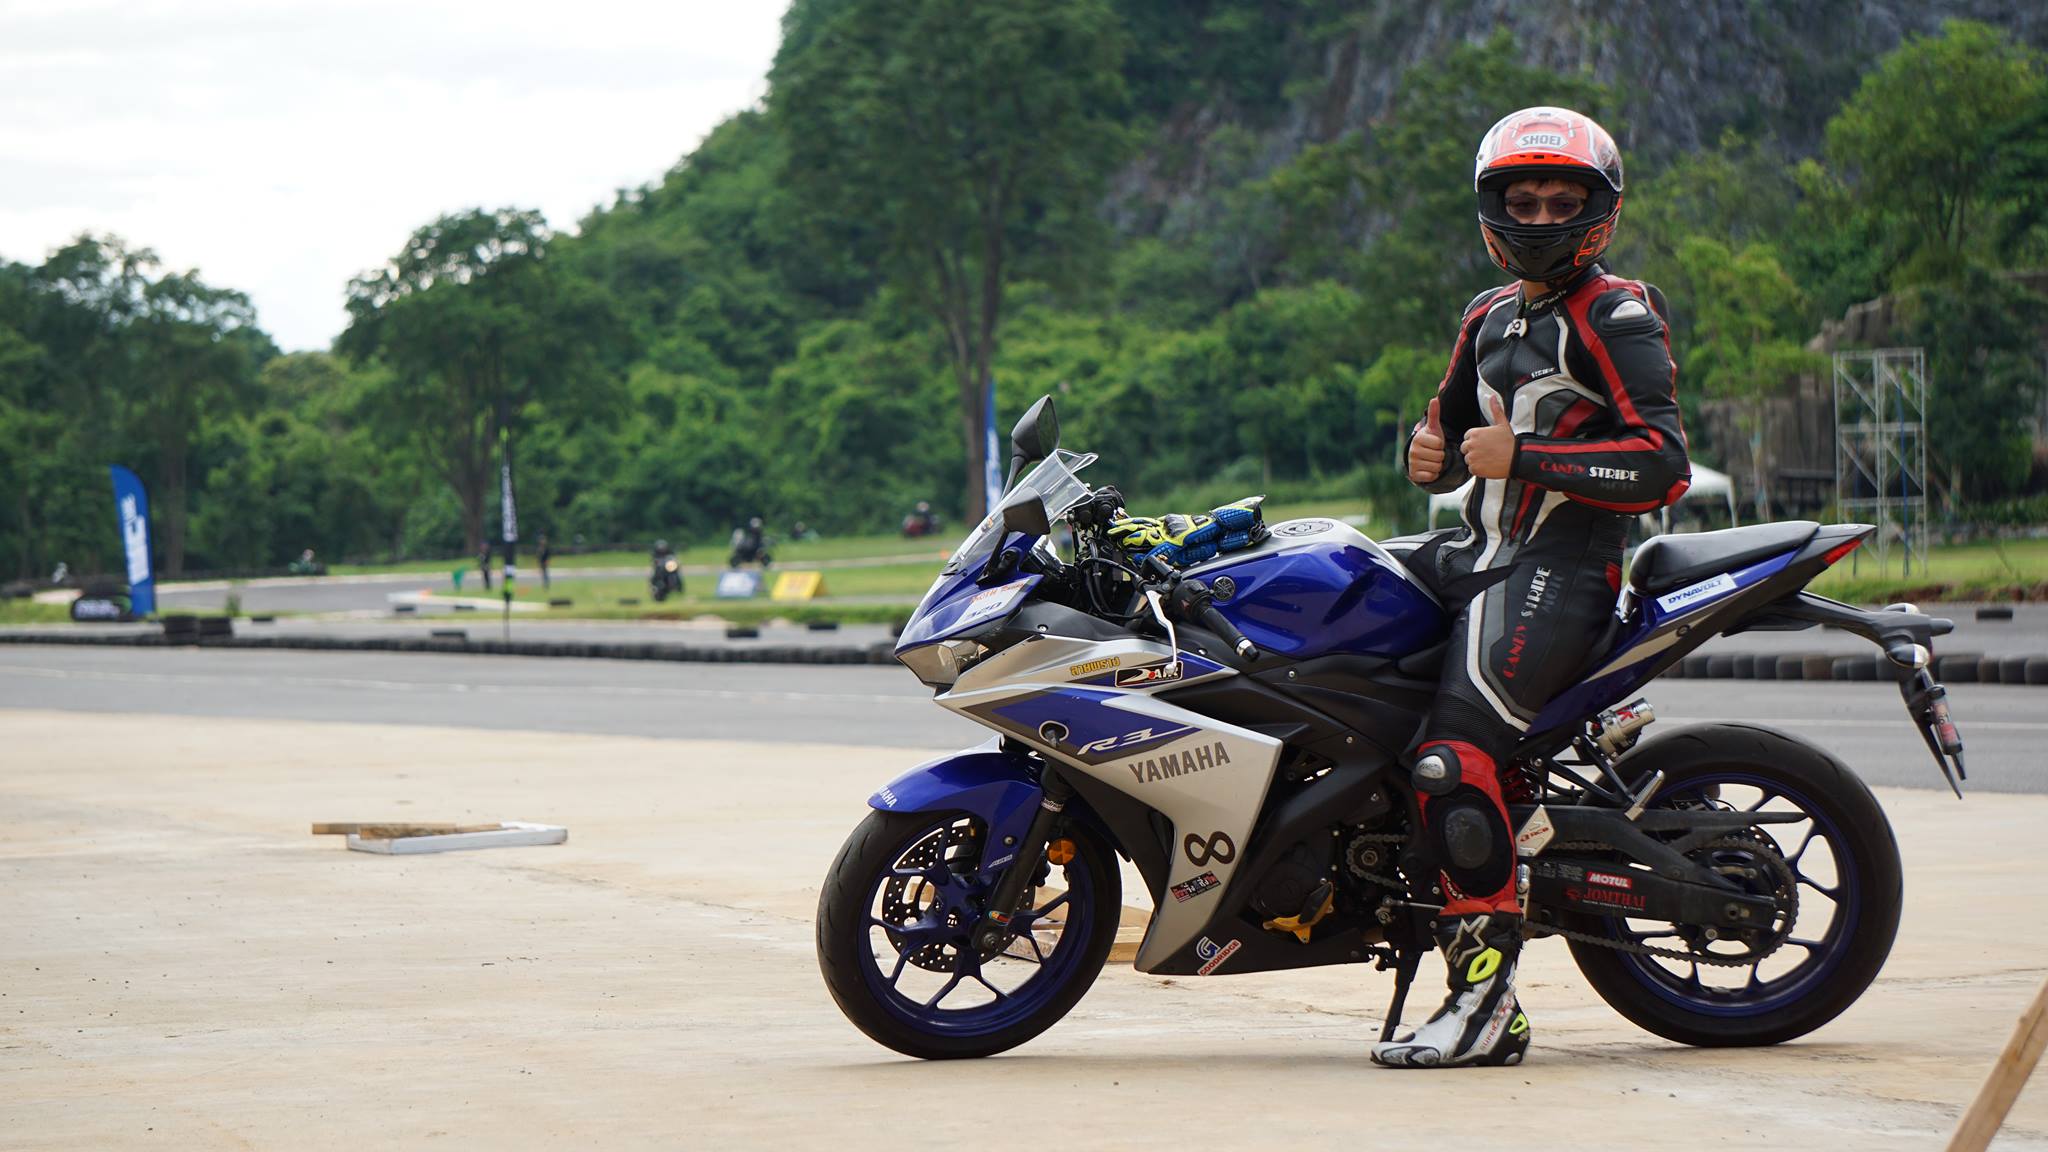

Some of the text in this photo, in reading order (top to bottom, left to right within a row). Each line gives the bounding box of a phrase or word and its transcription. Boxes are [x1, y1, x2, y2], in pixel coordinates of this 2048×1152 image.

[1521, 134, 1562, 146] SHOEI
[1539, 461, 1640, 482] CANDY STRIPE
[1520, 566, 1552, 619] STRIPE
[1667, 580, 1723, 605] DYNAVOLT
[1128, 741, 1231, 785] YAMAHA
[1588, 872, 1631, 889] MOTUL
[1583, 887, 1648, 910] JOMTHAI
[1199, 940, 1240, 977] GOODRIDGE
